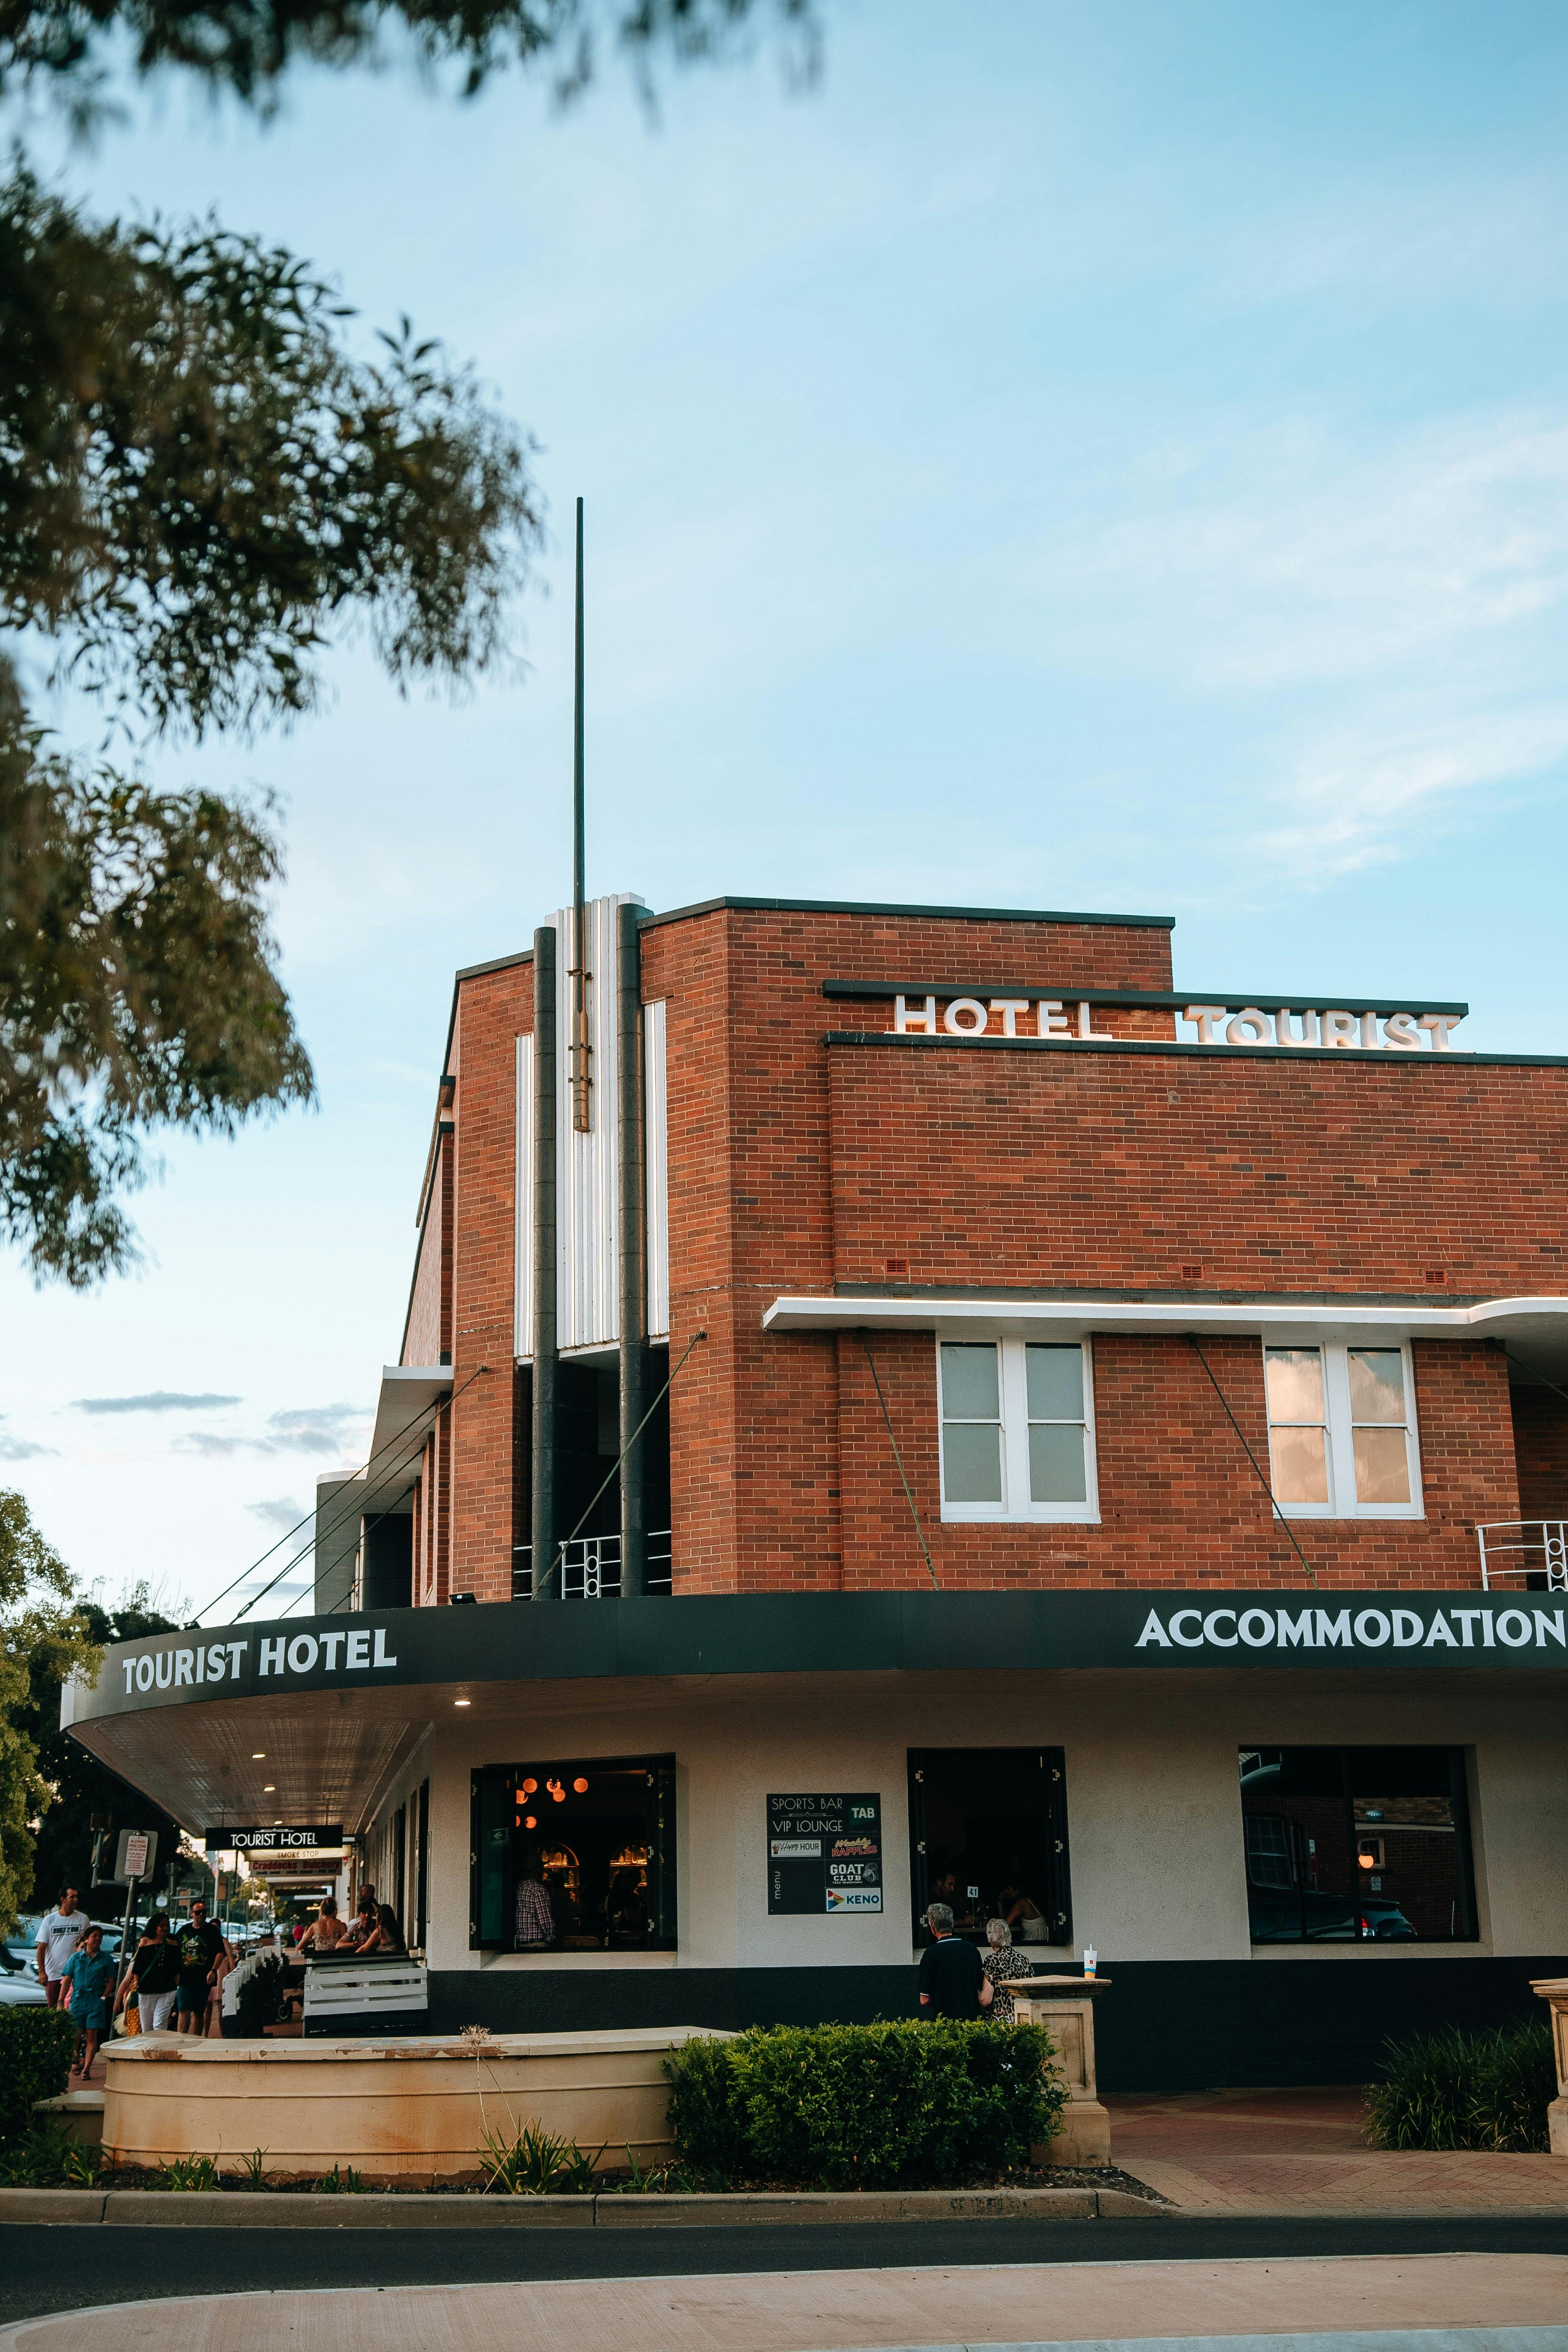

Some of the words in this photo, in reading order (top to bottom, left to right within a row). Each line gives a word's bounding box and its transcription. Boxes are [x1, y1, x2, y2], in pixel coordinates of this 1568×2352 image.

[893, 995, 1113, 1041] HOTEL
[1183, 1004, 1461, 1051] TOURIST
[1134, 1608, 1567, 1647] ACCOMMODATION
[122, 1641, 248, 1694] TOURIST
[259, 1629, 397, 1676] HOTEL
[772, 1798, 814, 1810] SPORTS
[821, 1798, 842, 1809] BAR
[852, 1808, 875, 1818] TAB
[773, 1821, 791, 1832] VIP
[797, 1820, 843, 1832] LOUNGE
[231, 1834, 276, 1846] TOURIST
[281, 1833, 318, 1845] HOTEL
[835, 1838, 871, 1848] Weekly
[781, 1842, 798, 1851] Happy
[832, 1845, 877, 1857] RAFFLES
[253, 1861, 297, 1870] Craddocks
[302, 1859, 339, 1868] Butchery
[847, 1895, 879, 1904] KENO
